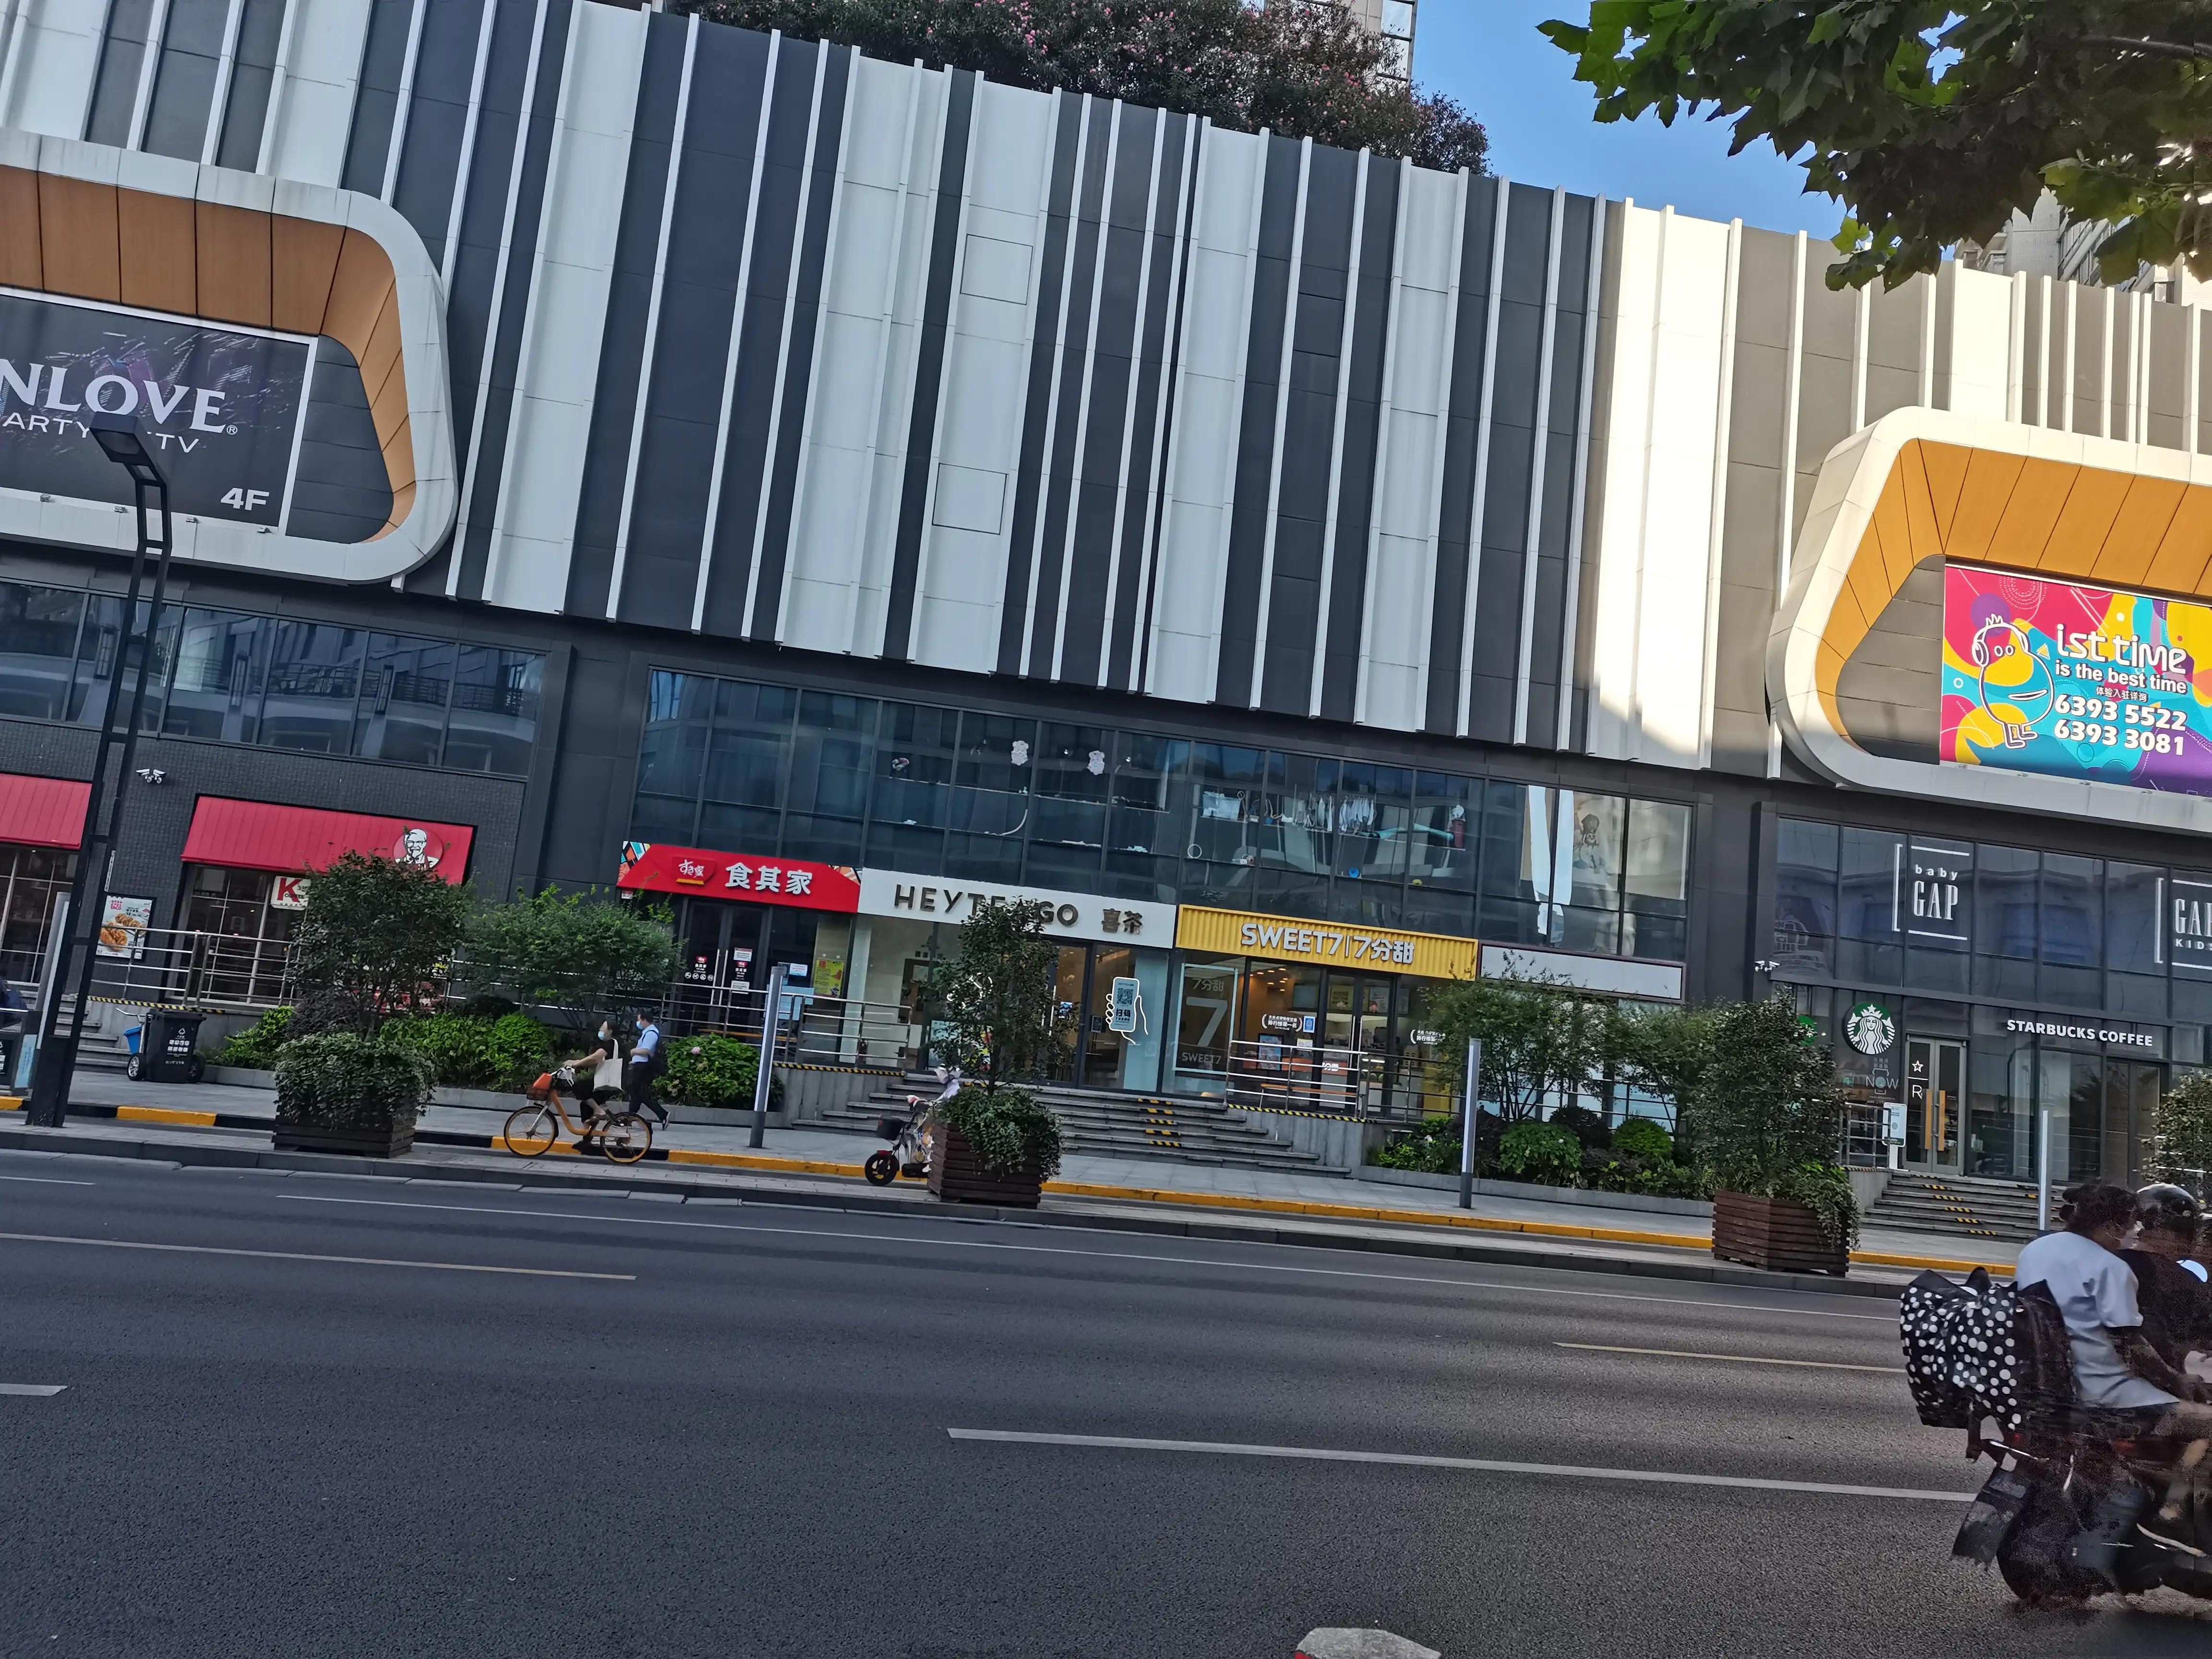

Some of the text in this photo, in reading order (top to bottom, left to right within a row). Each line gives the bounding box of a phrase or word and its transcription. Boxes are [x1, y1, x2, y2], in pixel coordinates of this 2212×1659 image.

[221, 487, 270, 511] 4F
[2056, 659, 2188, 694] is the best time
[2055, 694, 2187, 731] 6393 5522
[2054, 719, 2184, 756] 6393 3081
[725, 862, 813, 894] 食其家
[1914, 864, 1958, 880] baby
[1913, 880, 1959, 920] GAP
[1101, 908, 1143, 934] 喜茶
[1192, 978, 1224, 991] 7分甜
[2007, 1020, 2153, 1046] STARBUCKS COFFEE
[1181, 1052, 1221, 1064] SWEET7
